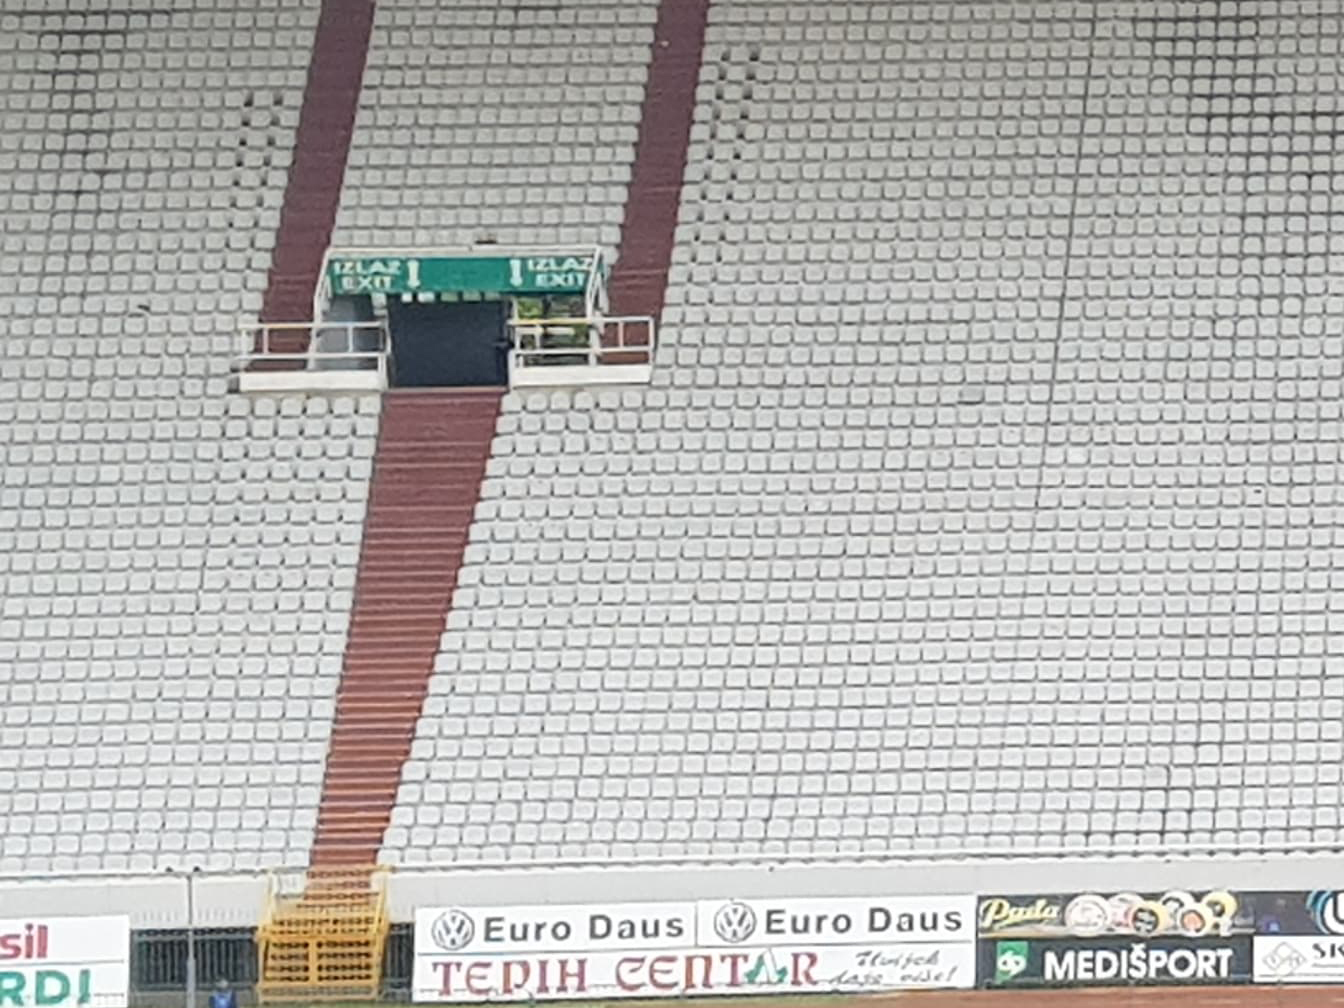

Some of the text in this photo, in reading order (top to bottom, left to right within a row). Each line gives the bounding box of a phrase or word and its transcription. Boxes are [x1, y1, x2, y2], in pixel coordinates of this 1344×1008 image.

[333, 260, 401, 275] IZLAZ
[527, 258, 594, 272] IZLAZ
[341, 276, 394, 290] EXIT
[535, 273, 587, 287] EXIT
[484, 913, 685, 943] Euro Daus
[765, 906, 963, 935] Euro Daus
[1044, 943, 1233, 981] MEDIŠPORT
[431, 950, 820, 997] TEPIH CENTAR
